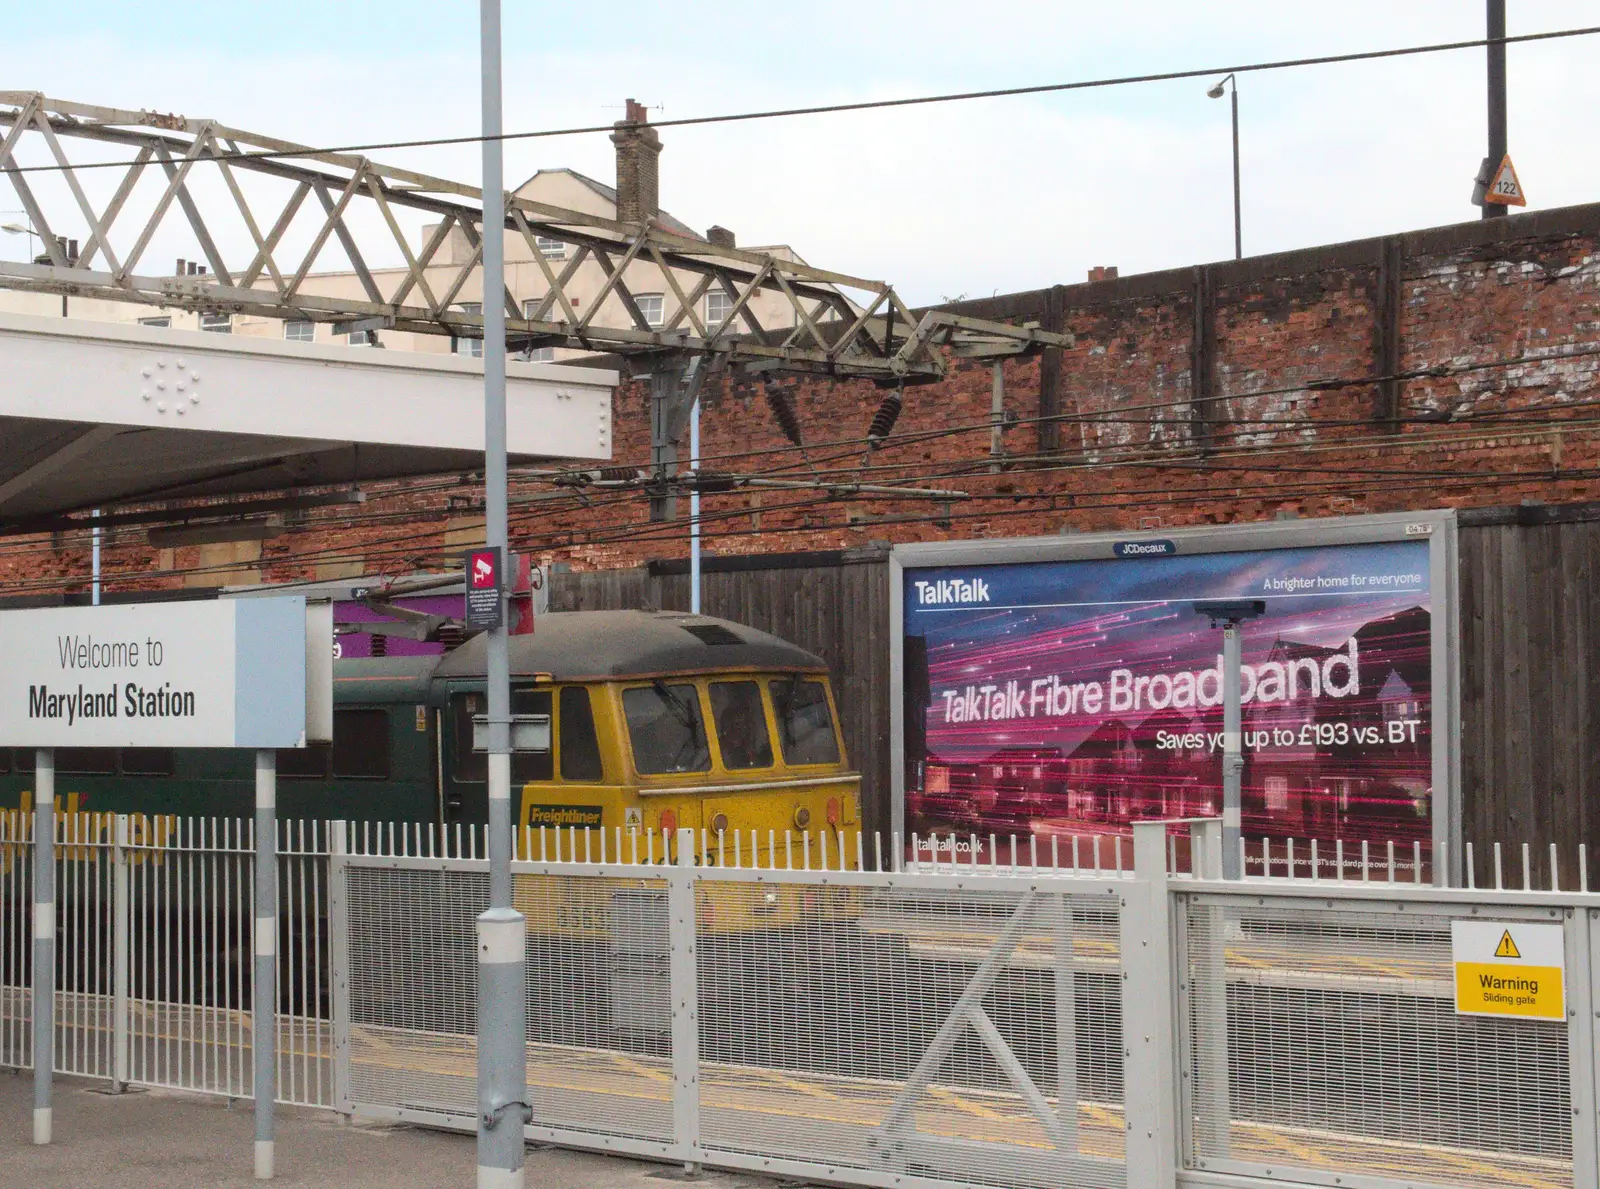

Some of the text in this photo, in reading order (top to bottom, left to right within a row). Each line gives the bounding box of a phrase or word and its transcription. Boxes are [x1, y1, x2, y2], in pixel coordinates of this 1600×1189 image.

[1498, 181, 1516, 195] 122
[1122, 544, 1167, 554] JCDecaux
[915, 578, 990, 604] TalkTalk
[1263, 574, 1421, 592] A brighter home for everyone
[58, 634, 163, 669] Welcome to
[29, 682, 195, 727] Maryland Station
[942, 680, 1026, 723] TalkTalk
[1029, 675, 1104, 718] Fibre
[1156, 720, 1421, 754] Saves yo up to £193 vs. BT
[531, 808, 600, 826] Freightliner
[1479, 974, 1538, 995] Warning
[1483, 992, 1536, 1006] Sliding gate
